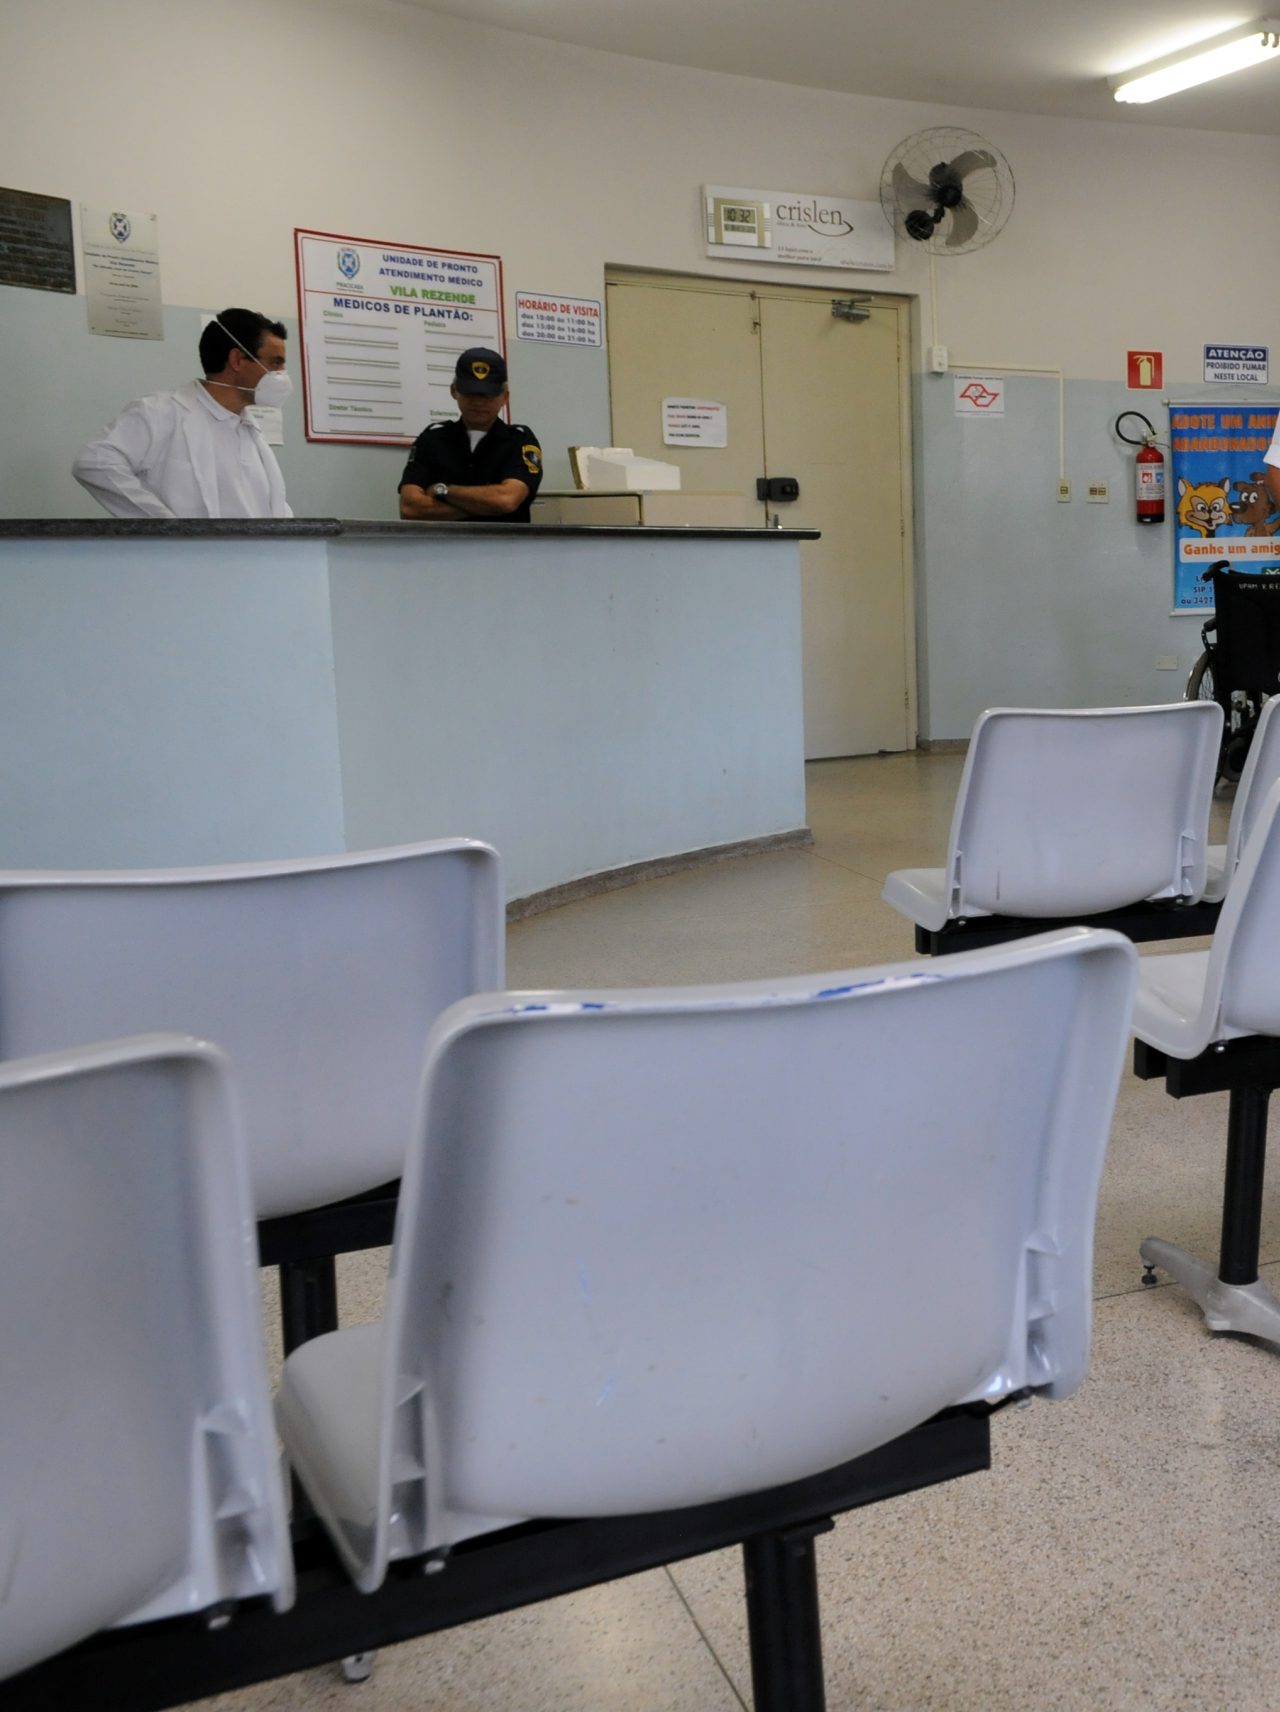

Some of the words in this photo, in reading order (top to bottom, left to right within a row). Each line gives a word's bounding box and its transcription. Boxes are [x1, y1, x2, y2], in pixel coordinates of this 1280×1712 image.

[776, 200, 843, 225] crislen
[382, 254, 424, 267] UNIDADE
[427, 259, 439, 269] DE
[442, 261, 478, 274] PRONTO
[379, 267, 445, 283] ATENDIMENTO
[448, 274, 483, 288] MÉDICO
[389, 285, 418, 299] VILA
[421, 288, 476, 305] REZENDE
[394, 303, 410, 315] DE
[414, 306, 473, 322] PLANTÃO:
[518, 298, 558, 313] HORÁRIO
[560, 304, 571, 314] DE
[573, 305, 599, 317] VISITA
[1209, 348, 1264, 360] ATENÇÃO
[1206, 361, 1240, 370] PROIBIDO
[1242, 362, 1266, 371] FUMAR
[1214, 372, 1235, 381] NESTE
[1237, 373, 1258, 381] LOCAL
[1172, 414, 1216, 430] ADOTE
[1220, 414, 1243, 430] UM
[1184, 544, 1224, 555] Ganhe
[1228, 545, 1247, 554] um
